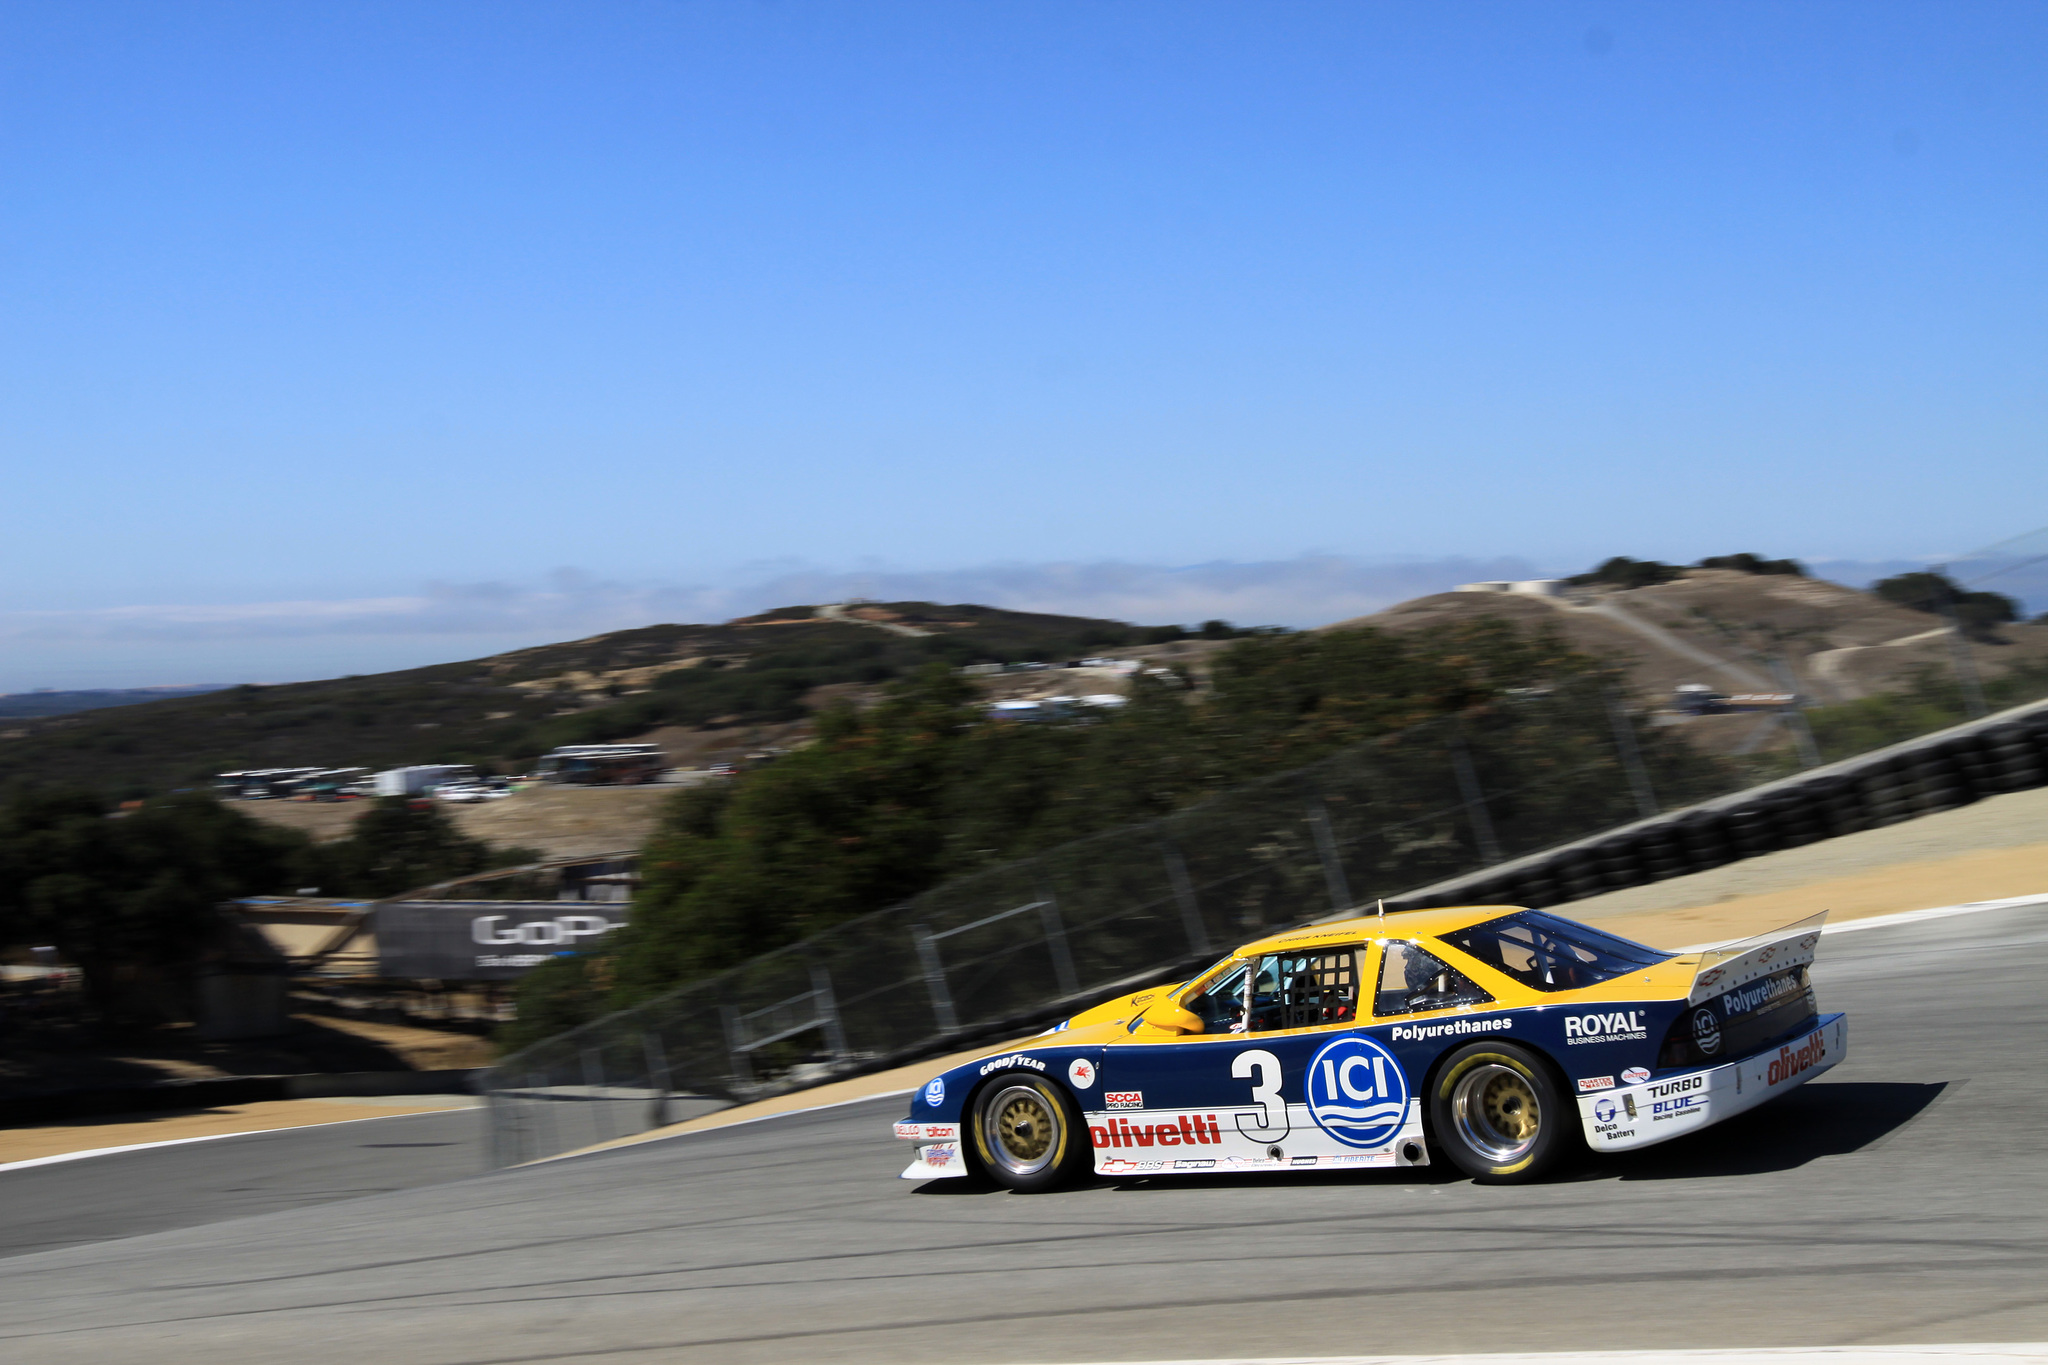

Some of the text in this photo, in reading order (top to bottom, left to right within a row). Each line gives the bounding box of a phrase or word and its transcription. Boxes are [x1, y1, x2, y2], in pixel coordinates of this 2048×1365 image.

[471, 915, 630, 945] GoP
[1723, 974, 1797, 1015] Polyurethanes
[1392, 1018, 1512, 1041] Polyurethanes
[1695, 1015, 1716, 1037] ICI
[1567, 1031, 1648, 1046] BUSINESS MACHINES
[979, 1054, 1046, 1076] GOODYEAR
[1767, 1030, 1825, 1086] olivetti
[1322, 1055, 1389, 1101] ICI
[1579, 1077, 1611, 1087] QUARTER
[1585, 1081, 1614, 1089] MASTER
[1647, 1077, 1702, 1098] TURBO
[1106, 1093, 1142, 1103] SCCA
[1231, 1049, 1291, 1144] 3
[1653, 1096, 1699, 1114] BLUE
[926, 1126, 955, 1138] tilton
[1089, 1114, 1222, 1148] olivetti
[1594, 1123, 1618, 1133] Delco
[1606, 1129, 1636, 1140] Battery
[1137, 1160, 1164, 1170] BBS
